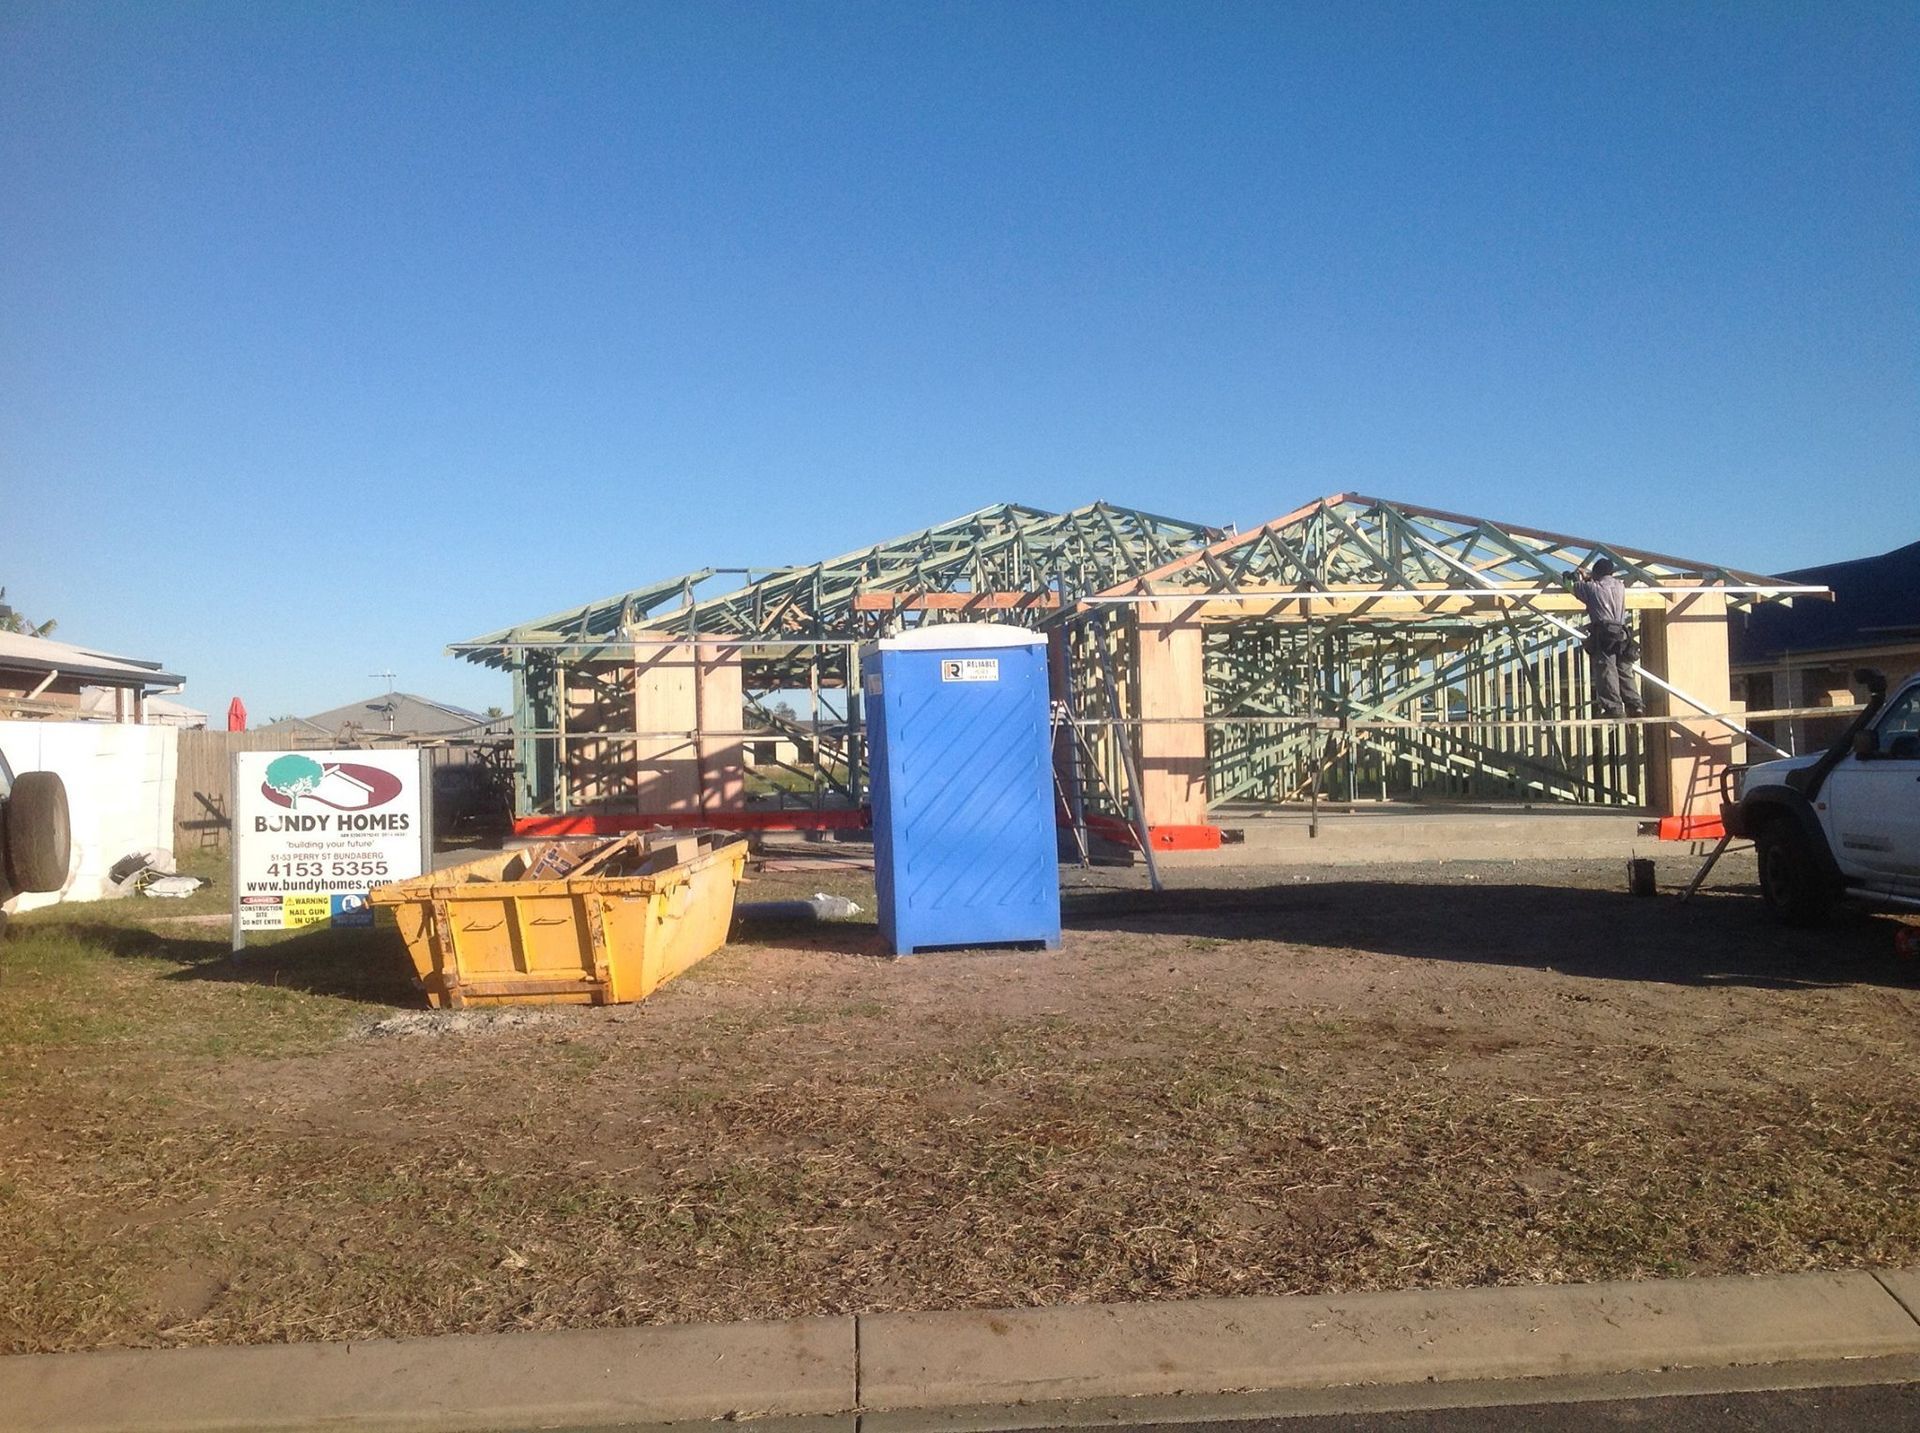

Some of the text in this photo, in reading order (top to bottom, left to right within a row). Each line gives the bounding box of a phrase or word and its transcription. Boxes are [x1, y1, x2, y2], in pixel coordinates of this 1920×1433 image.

[254, 813, 410, 833] BUNDY HOMES
[325, 841, 345, 850] your
[270, 851, 384, 862] 51-53 PERRY ST BUNDABERG
[266, 861, 389, 877] 4153 5355
[294, 897, 329, 905] WARNING
